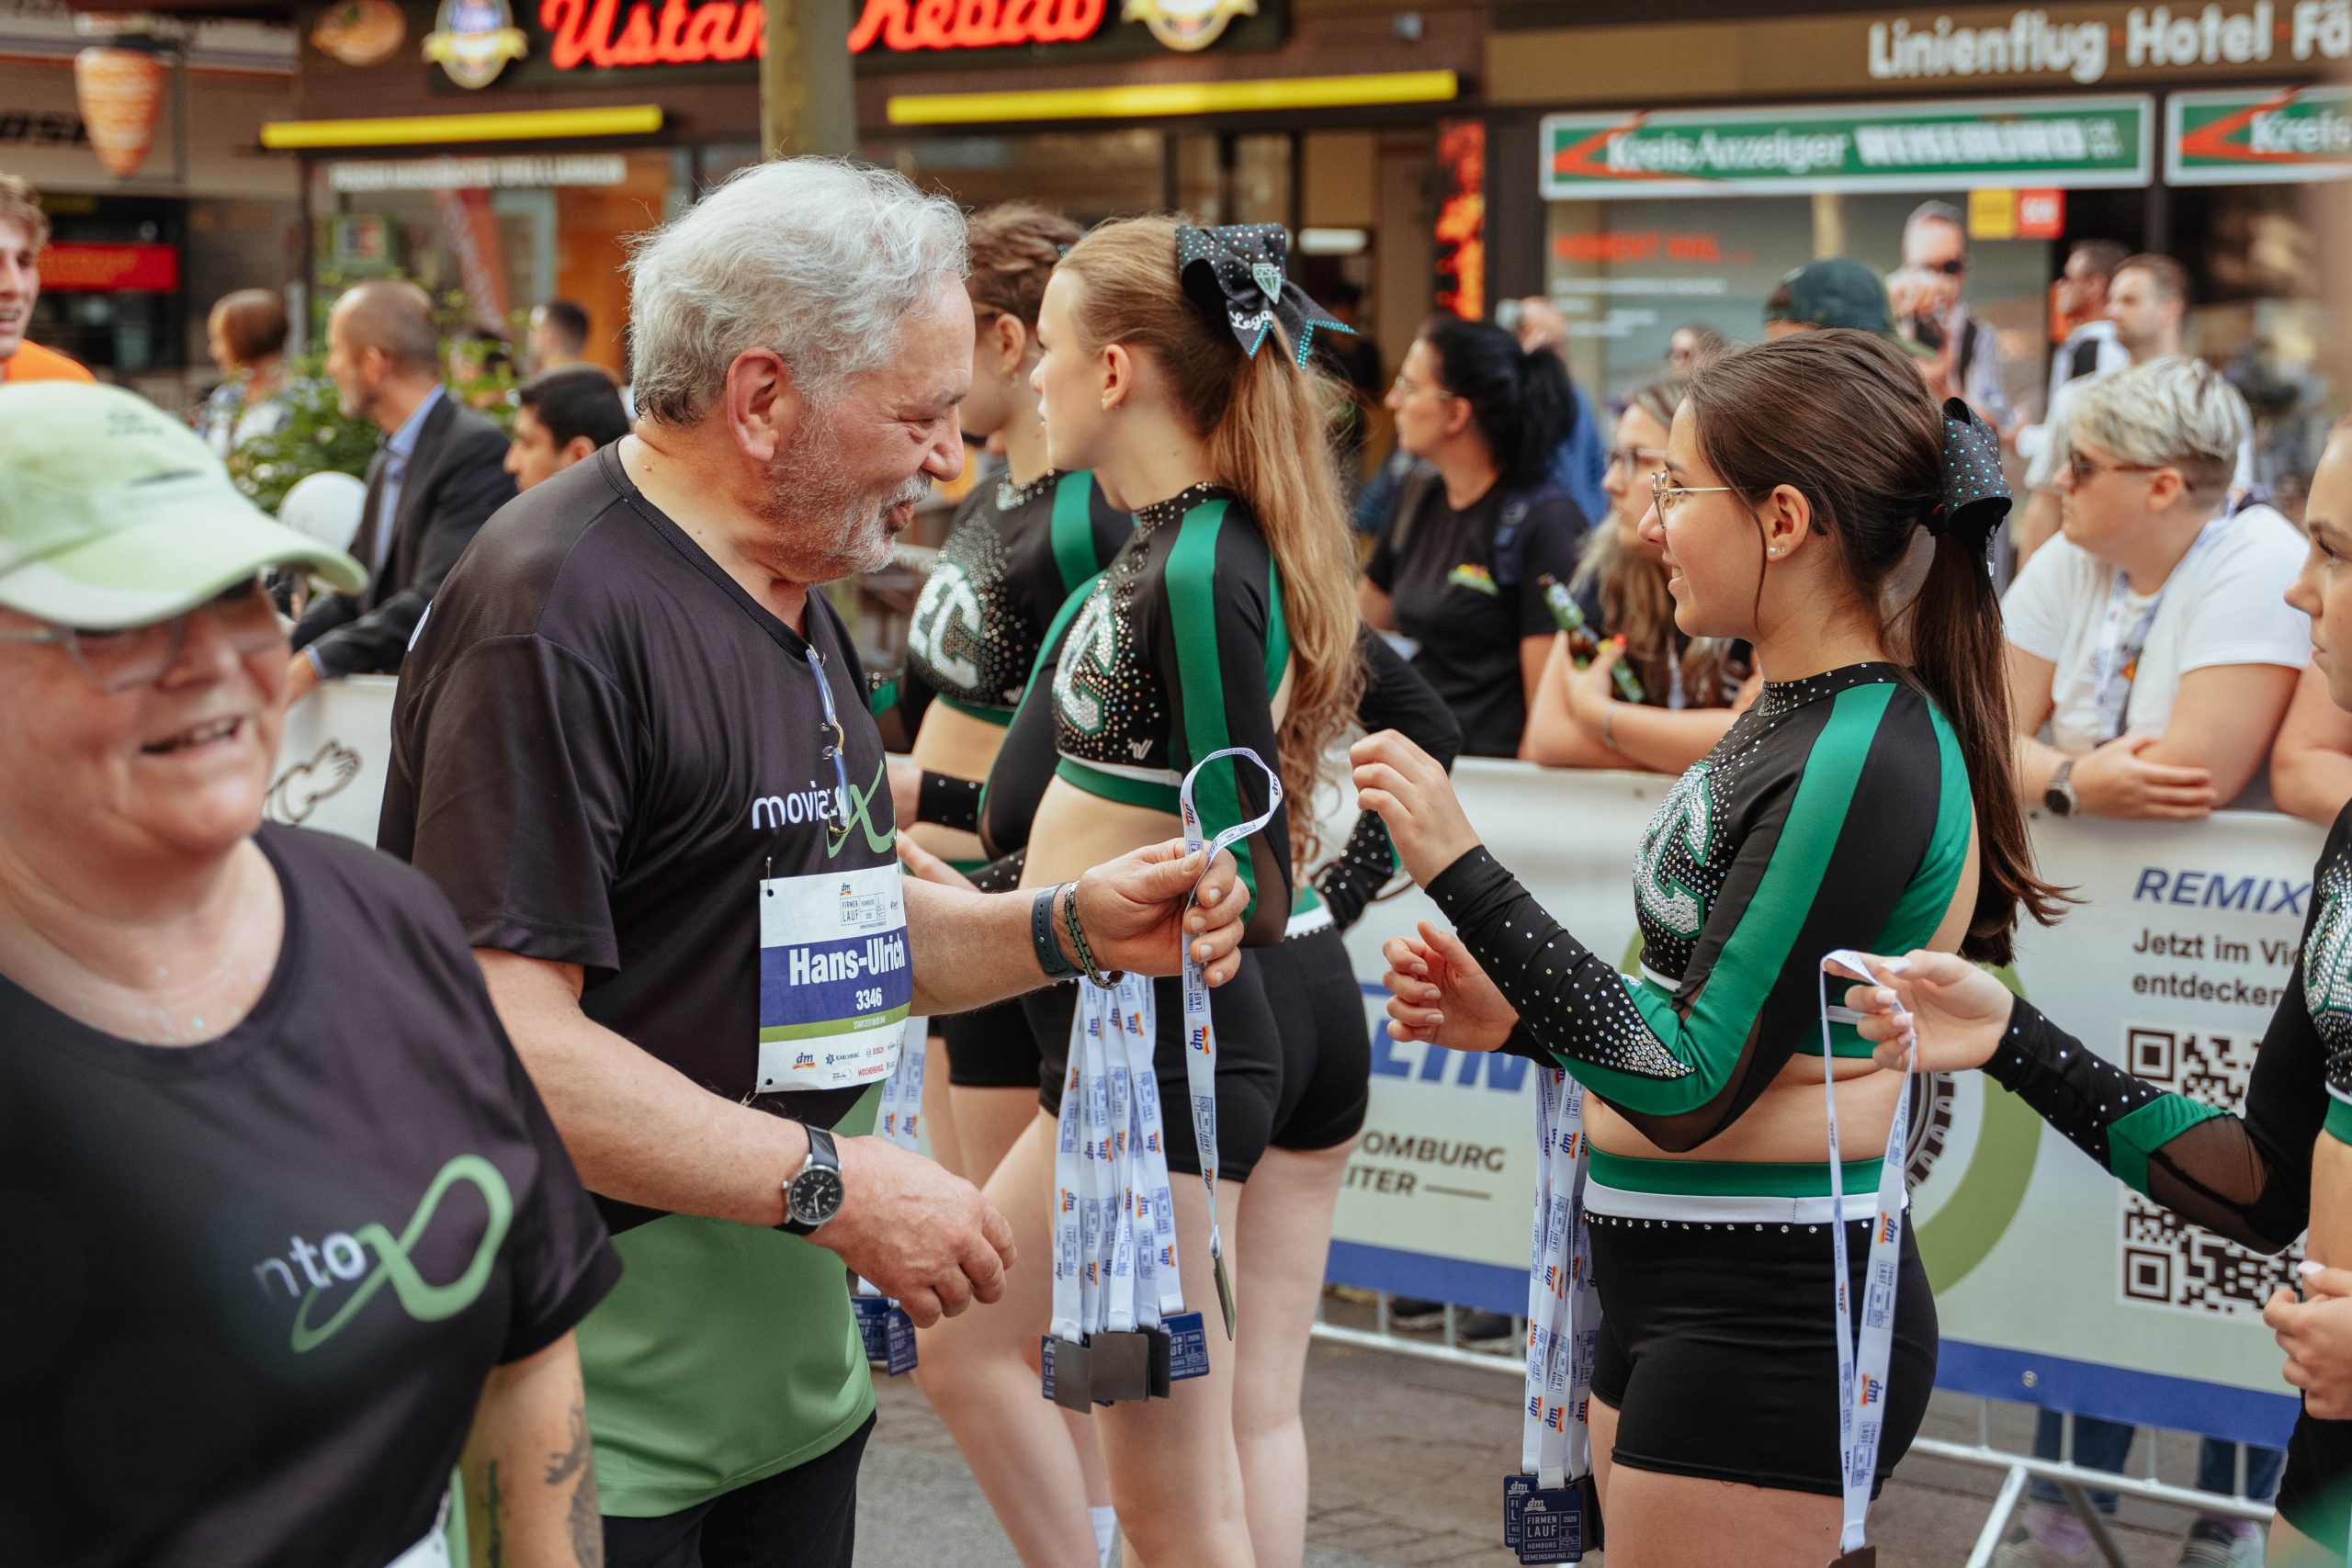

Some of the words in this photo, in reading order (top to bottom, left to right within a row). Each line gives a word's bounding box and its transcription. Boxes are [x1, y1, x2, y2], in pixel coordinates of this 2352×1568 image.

[1868, 10, 2109, 84] Linienflug
[2126, 1, 2274, 67] Hotel
[2132, 866, 2313, 918] REMIX
[842, 908, 859, 922] LAUF
[2132, 928, 2206, 959] Jetzt
[2214, 934, 2250, 964] im
[789, 932, 906, 987] Hans-Ulrich
[855, 987, 882, 1010] 3346
[2132, 972, 2285, 1009] entdecken
[1194, 992, 1203, 1010] LAUF
[1107, 1008, 1119, 1027] dm
[1125, 1016, 1137, 1034] dm
[1088, 1019, 1099, 1037] dm
[1190, 1029, 1204, 1050] dm
[796, 1052, 813, 1064] dm
[1571, 1098, 1580, 1116] LAUF
[1096, 1142, 1108, 1159] dm
[1146, 1134, 1156, 1152] dm
[1361, 1130, 1508, 1175] OMBURG
[1560, 1133, 1573, 1154] dm
[1345, 1163, 1419, 1198] ITER
[1068, 1192, 1077, 1211] dm
[1141, 1197, 1150, 1214] dm
[1885, 1218, 1898, 1243] dm
[1159, 1248, 1170, 1265] dm
[1544, 1266, 1554, 1286] dm
[1878, 1263, 1888, 1286] LAUF
[1549, 1371, 1557, 1391] FIRMEN
[1555, 1373, 1564, 1393] LAUF
[1867, 1379, 1883, 1404] dm
[1528, 1396, 1538, 1416] dm
[1576, 1402, 1586, 1422] dm
[1544, 1407, 1558, 1428] dm
[1510, 1480, 1529, 1491] dm
[1527, 1497, 1545, 1507] dm
[1527, 1516, 1558, 1525] FIRMEN
[1527, 1525, 1557, 1538] LAUF
[1527, 1541, 1558, 1551] HOMBURG
[1523, 1553, 1556, 1562] GEMEINSAM
